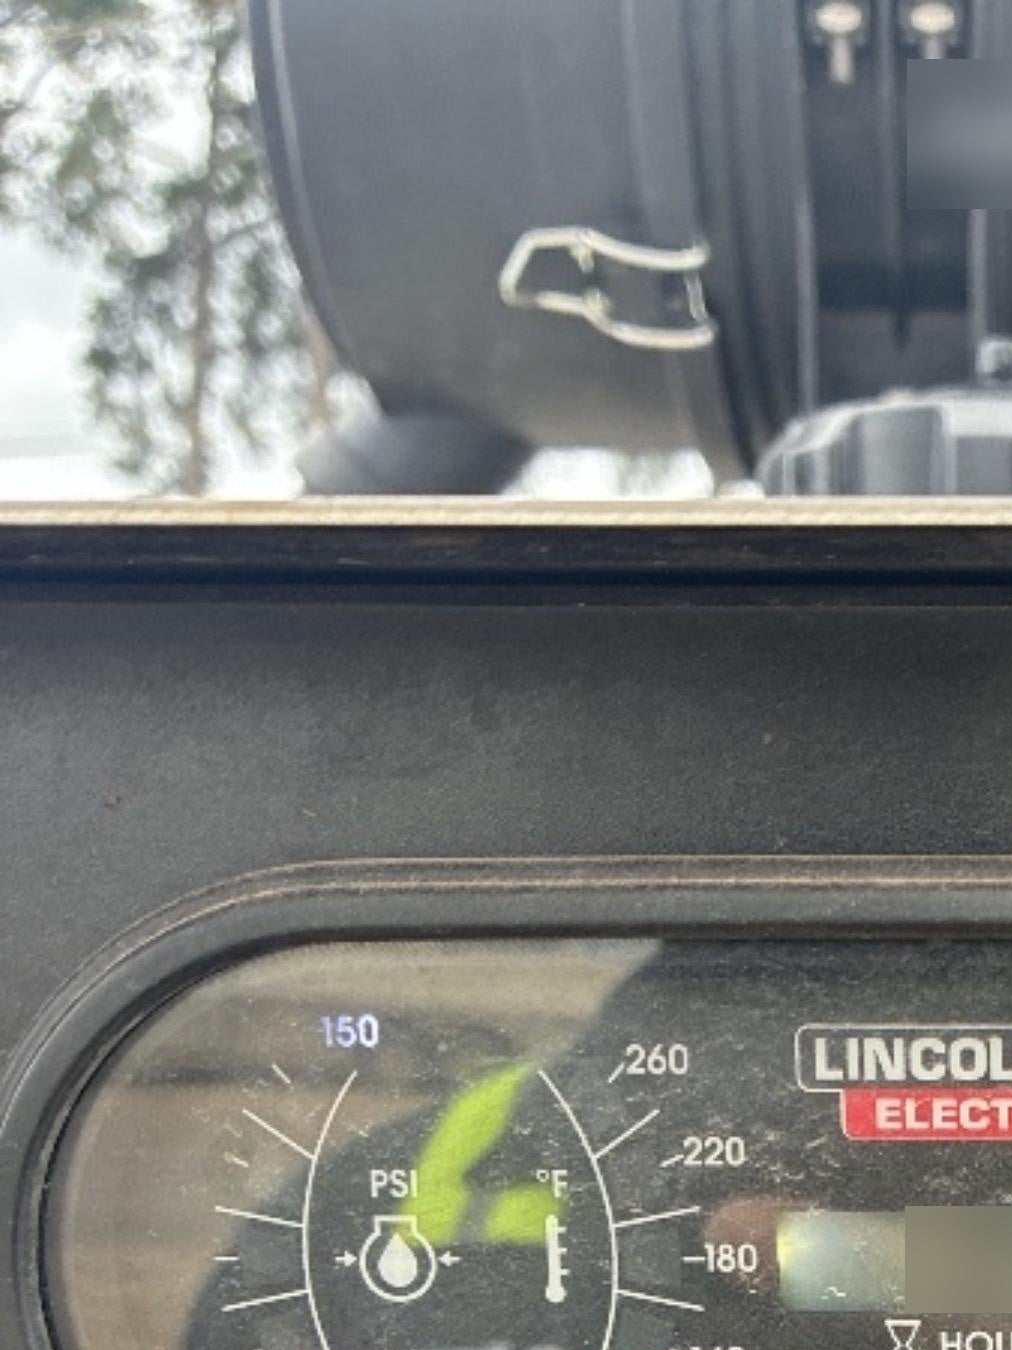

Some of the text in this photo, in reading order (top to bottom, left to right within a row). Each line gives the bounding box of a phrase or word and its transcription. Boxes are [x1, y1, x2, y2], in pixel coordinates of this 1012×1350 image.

[320, 1015, 380, 1048] 150
[624, 1044, 689, 1076] 260
[682, 1136, 747, 1168] 220
[369, 1169, 418, 1198] PSI
[705, 1242, 758, 1273] 180
